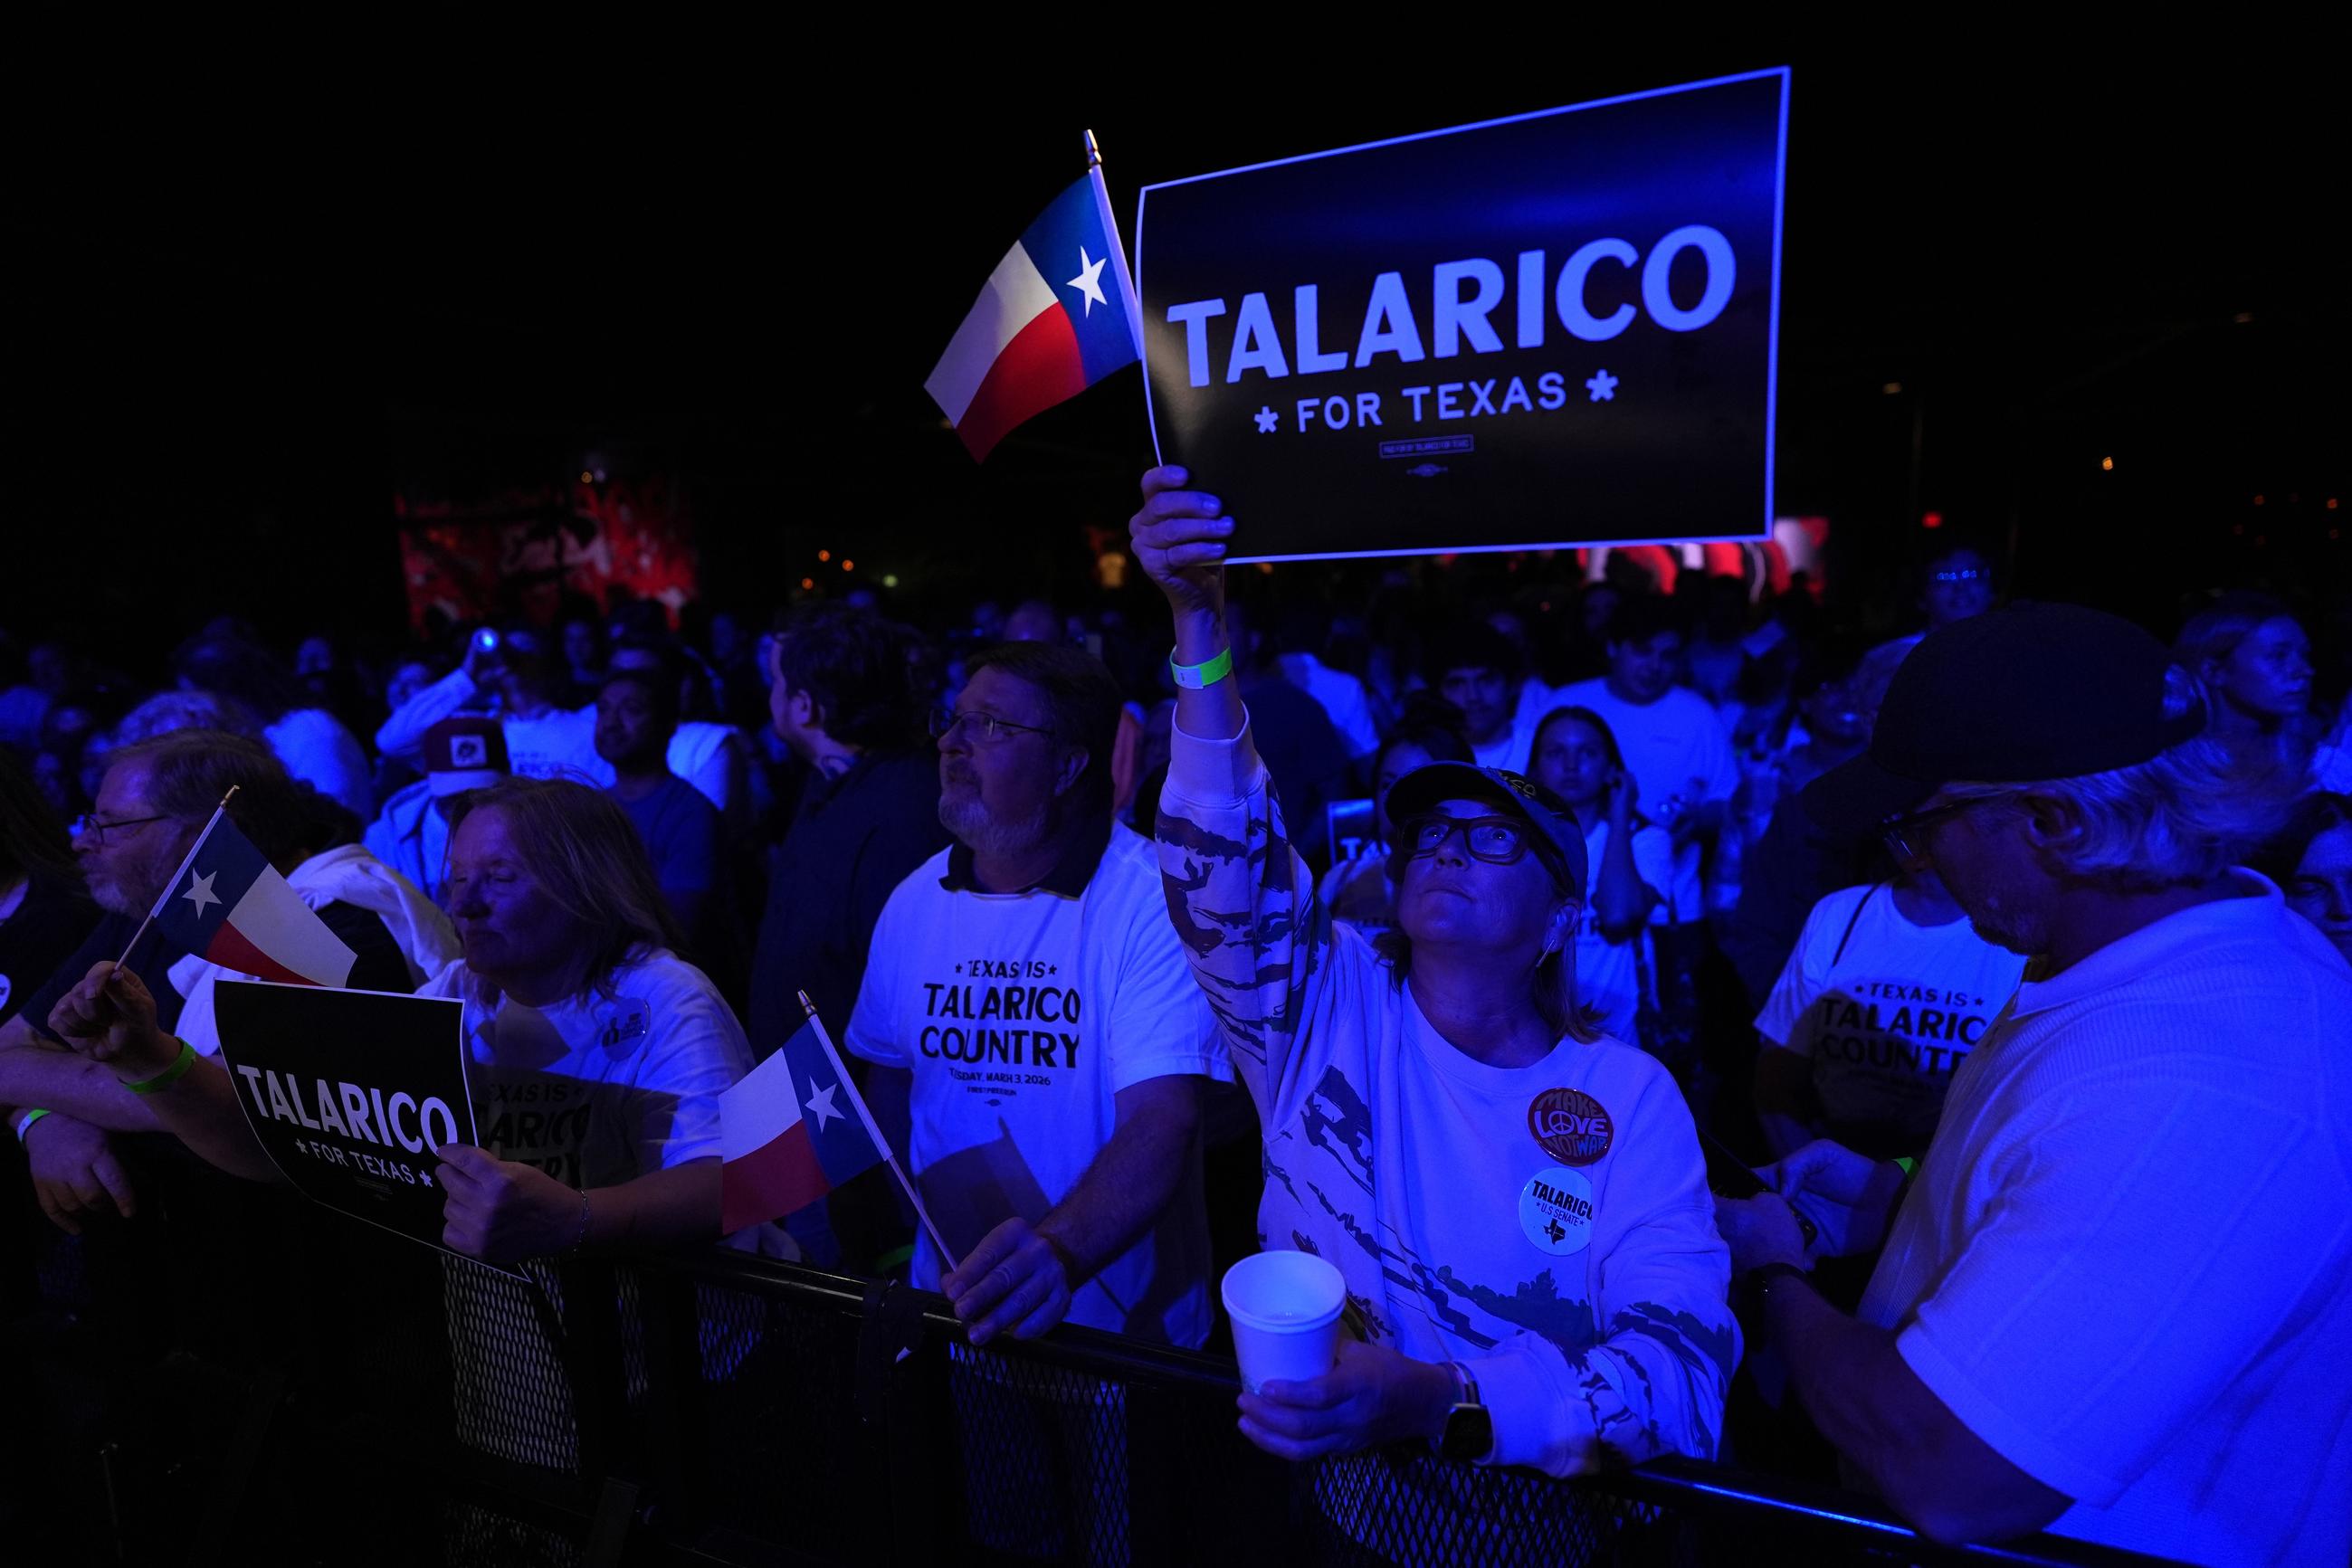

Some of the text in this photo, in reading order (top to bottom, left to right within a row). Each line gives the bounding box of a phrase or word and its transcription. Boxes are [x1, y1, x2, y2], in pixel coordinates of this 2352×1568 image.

[1166, 224, 1736, 388] TALARICO
[1298, 371, 1567, 432] FOR TEXAS
[1026, 961, 1046, 978] IS
[923, 983, 1081, 1024] TALARICO
[1870, 983, 1968, 1007] TEXAS IS
[1822, 998, 1987, 1045] TALARIC
[919, 1025, 1080, 1069] COUNTRY
[1822, 1033, 1967, 1080] COUNT
[545, 1083, 567, 1102] IS
[1024, 1074, 1051, 1086] 2026
[236, 1064, 458, 1156] TALARICO
[1534, 1110, 1608, 1138] LOVE
[1536, 1091, 1605, 1117] MAKE
[310, 1141, 349, 1167] FOR
[349, 1151, 417, 1185] TEXAS
[1553, 1208, 1580, 1227] SENATE
